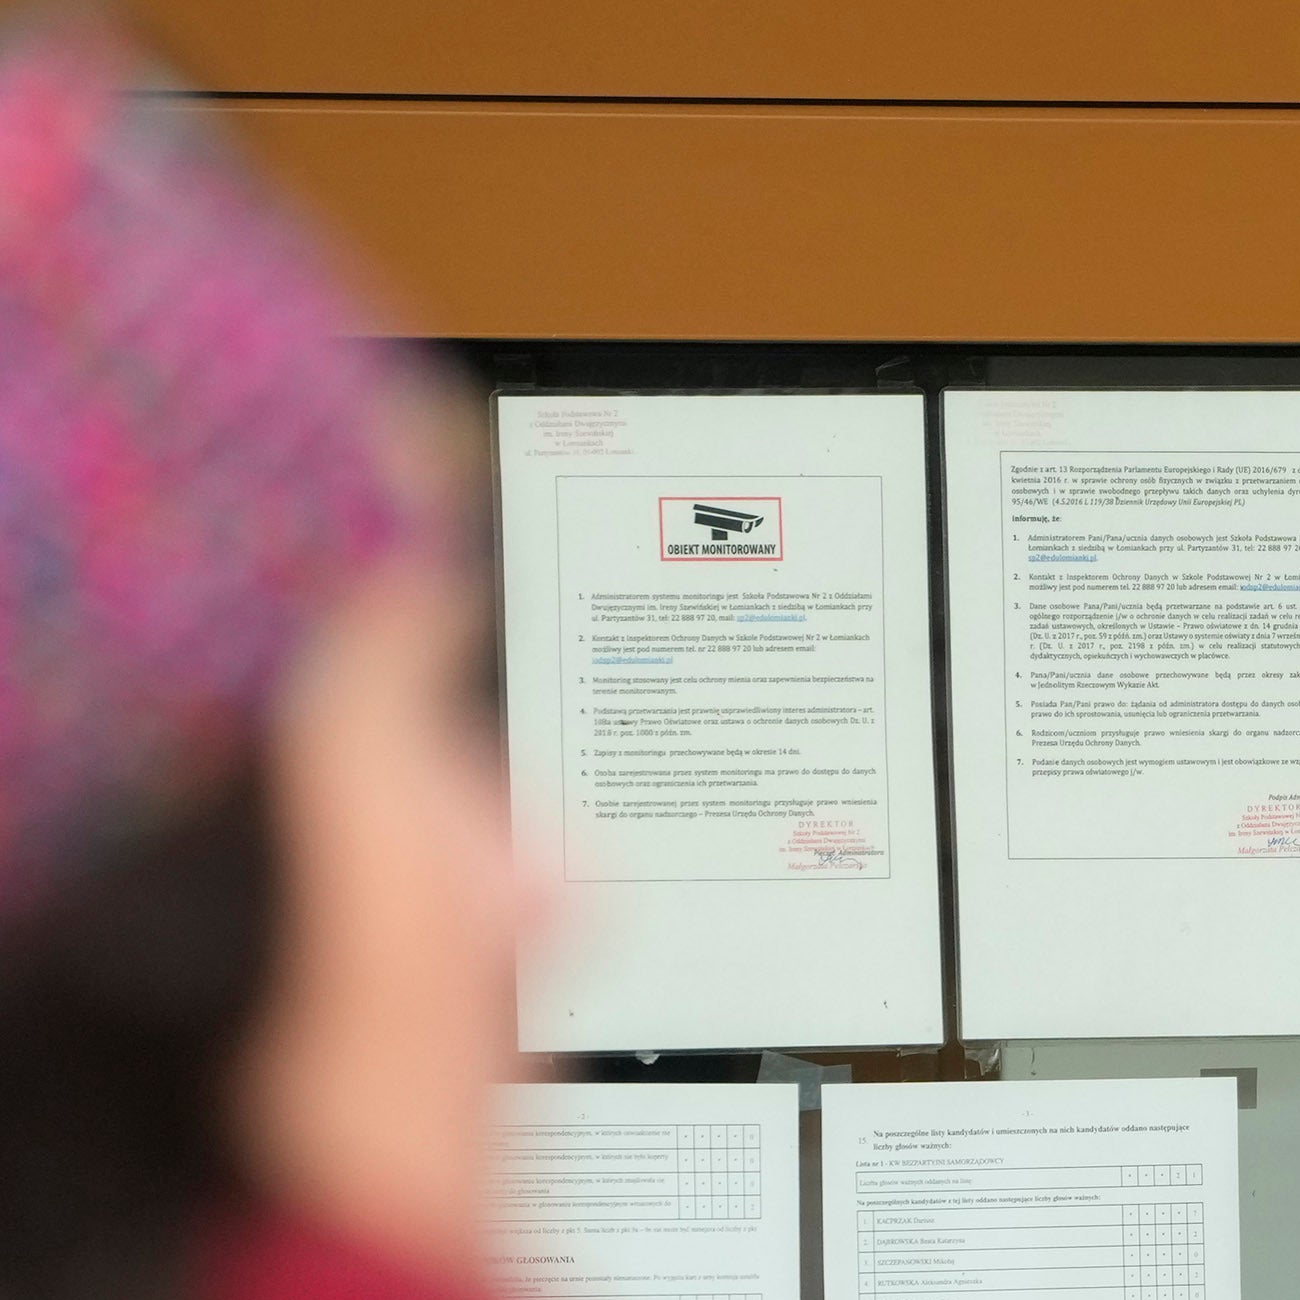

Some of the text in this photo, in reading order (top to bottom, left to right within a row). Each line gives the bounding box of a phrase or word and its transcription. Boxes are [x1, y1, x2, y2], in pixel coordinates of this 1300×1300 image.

[1010, 465, 1039, 474] Zgodnie
[1069, 465, 1122, 475] Rozporządzenia
[1124, 466, 1162, 474] Parlamentu
[1163, 466, 1212, 475] Europejskiego
[1216, 466, 1234, 475] Rady
[1235, 466, 1252, 475] (UE)
[1252, 466, 1287, 475] 2016/679
[1012, 514, 1050, 524] Informuję,
[667, 544, 776, 555] OBIEKT MONITOROWANY
[1247, 803, 1300, 814] DYREKTOR
[873, 1130, 884, 1138] Na
[885, 1130, 929, 1139] poszczególne
[931, 1129, 946, 1138] listy
[947, 1128, 990, 1138] kandydatów
[996, 1127, 1048, 1136] umieszczonych
[1059, 1126, 1075, 1134] nich
[1076, 1125, 1120, 1134] kandydatów
[1121, 1124, 1148, 1132] oddano
[1149, 1124, 1190, 1133] następujące
[873, 1142, 952, 1152] liczby głosów ważnych:
[516, 1256, 575, 1264] GŁOSOWANIA
